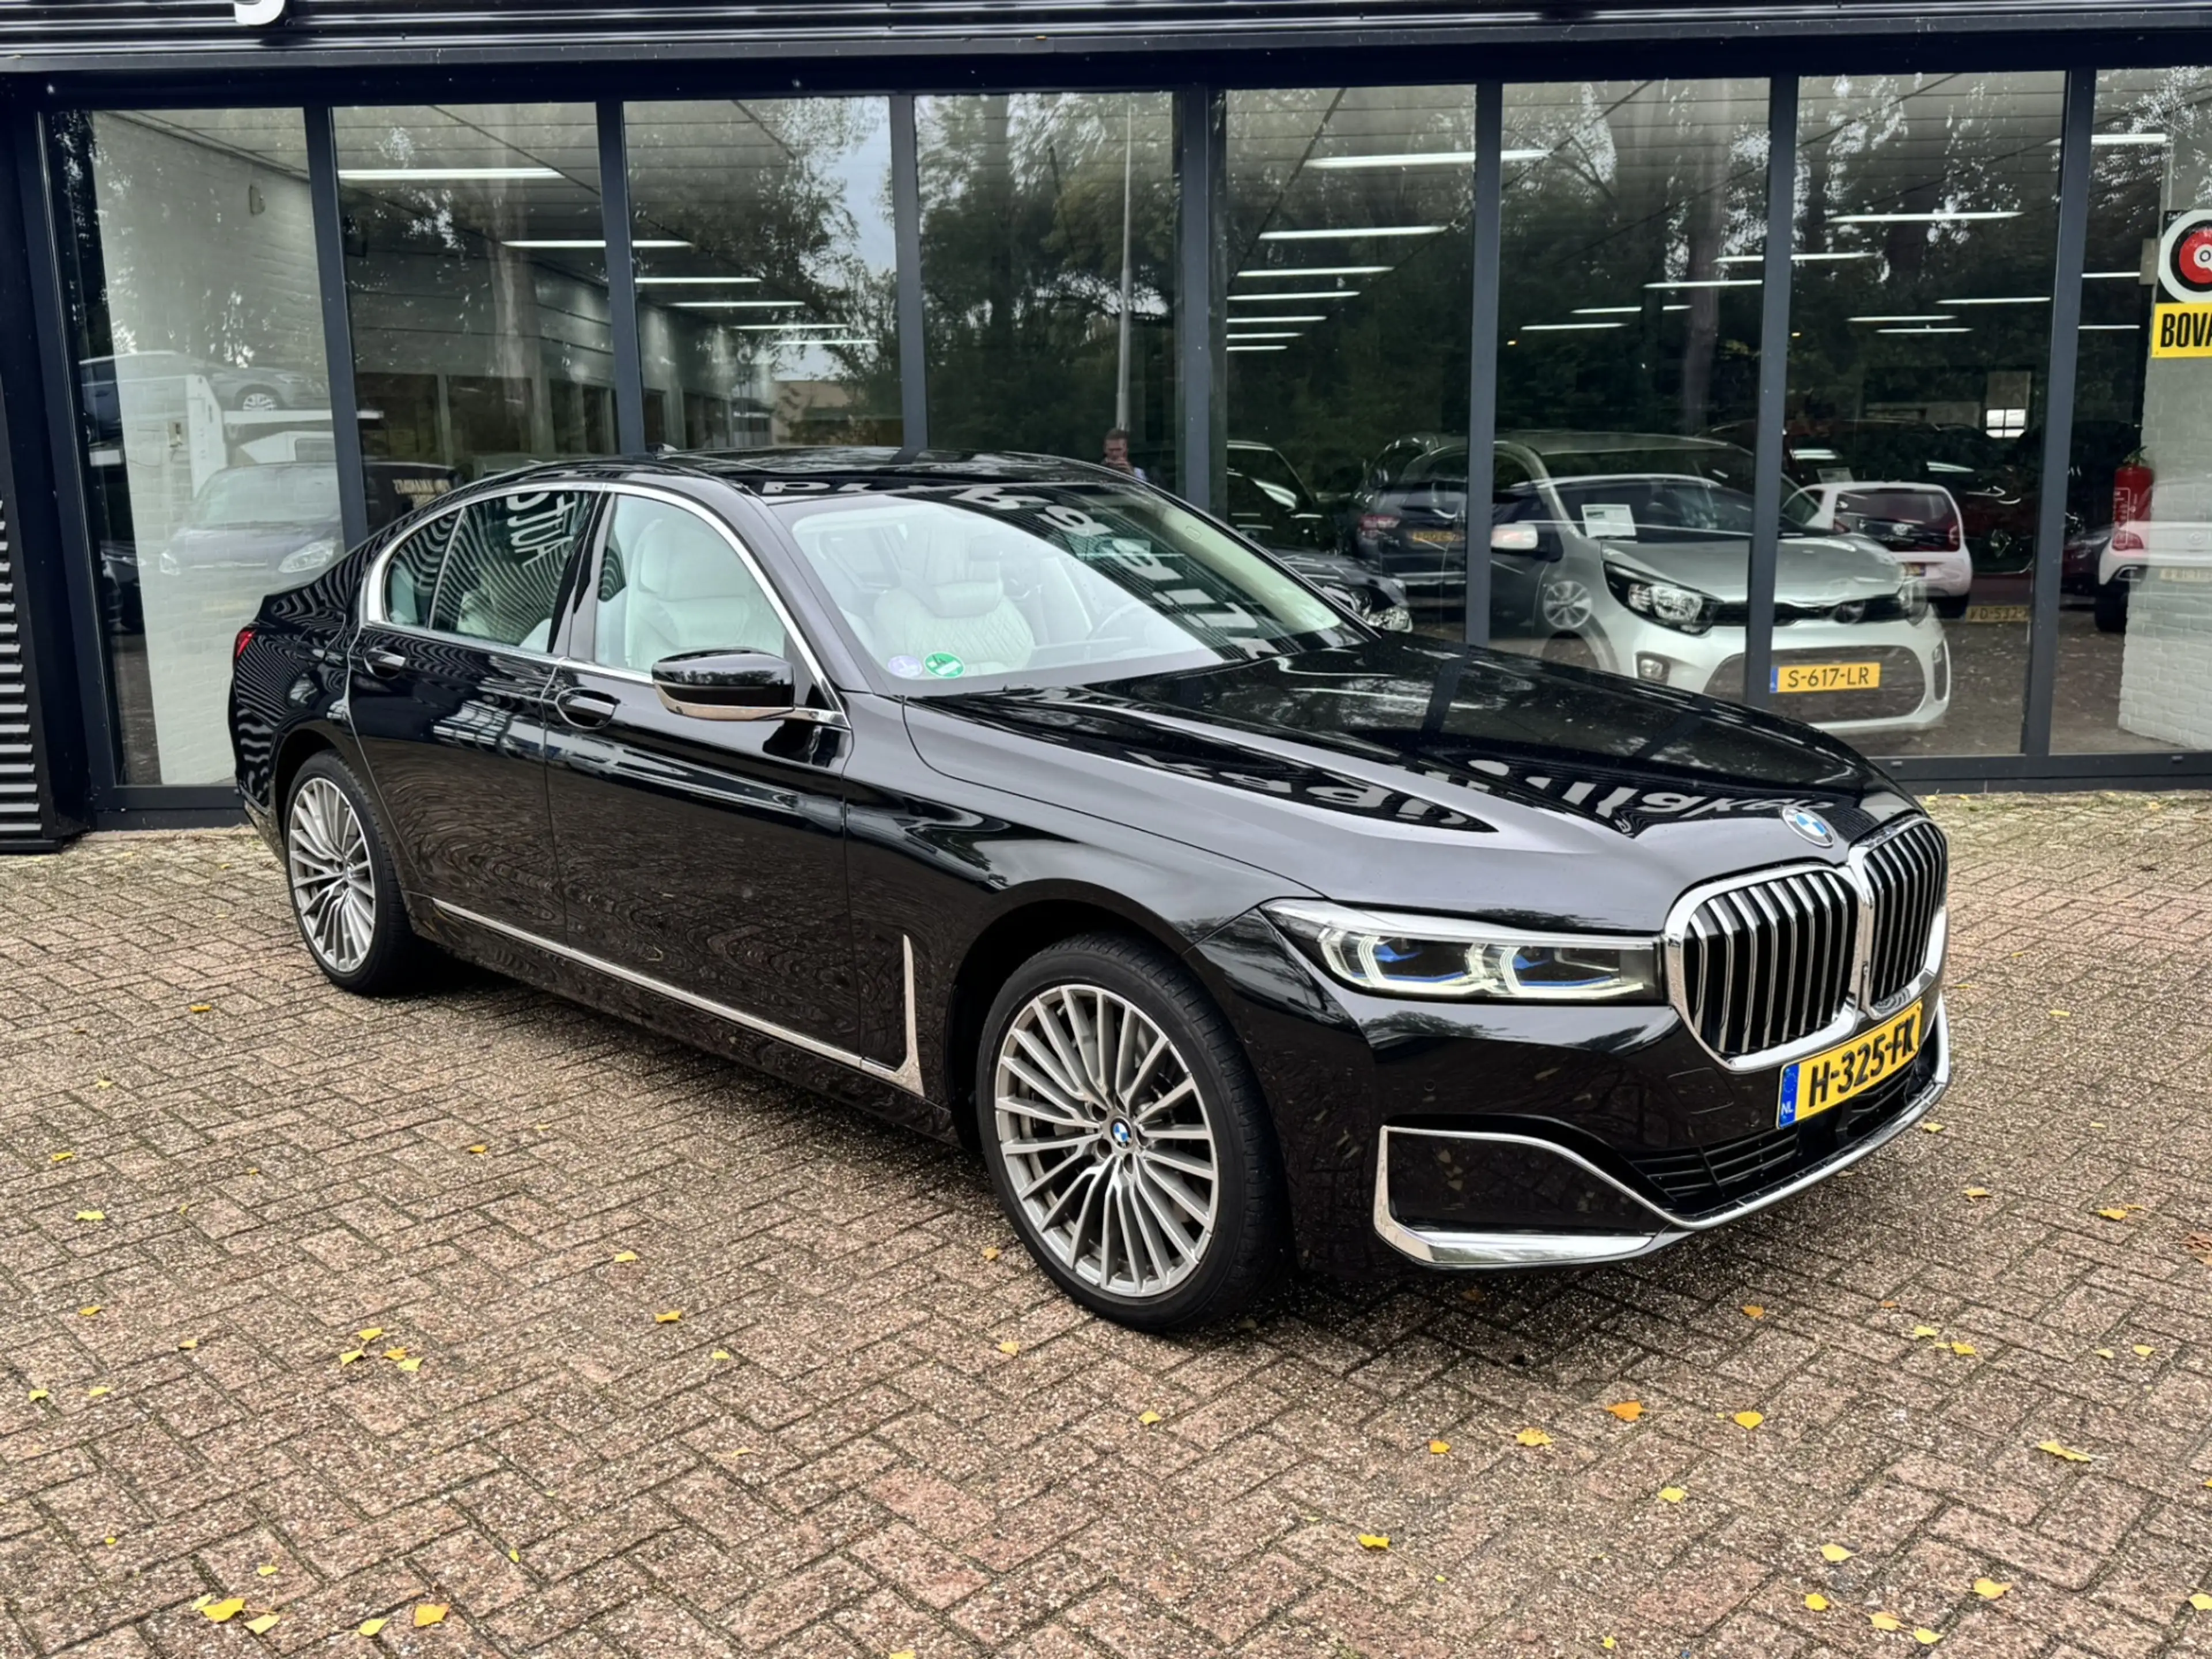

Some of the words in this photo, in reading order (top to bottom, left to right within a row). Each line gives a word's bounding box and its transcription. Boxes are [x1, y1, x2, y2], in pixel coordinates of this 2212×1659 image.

[1787, 666, 1869, 688] S-617-LR
[1809, 1013, 1915, 1108] H-325-FK
[1781, 1101, 1794, 1116] NL
